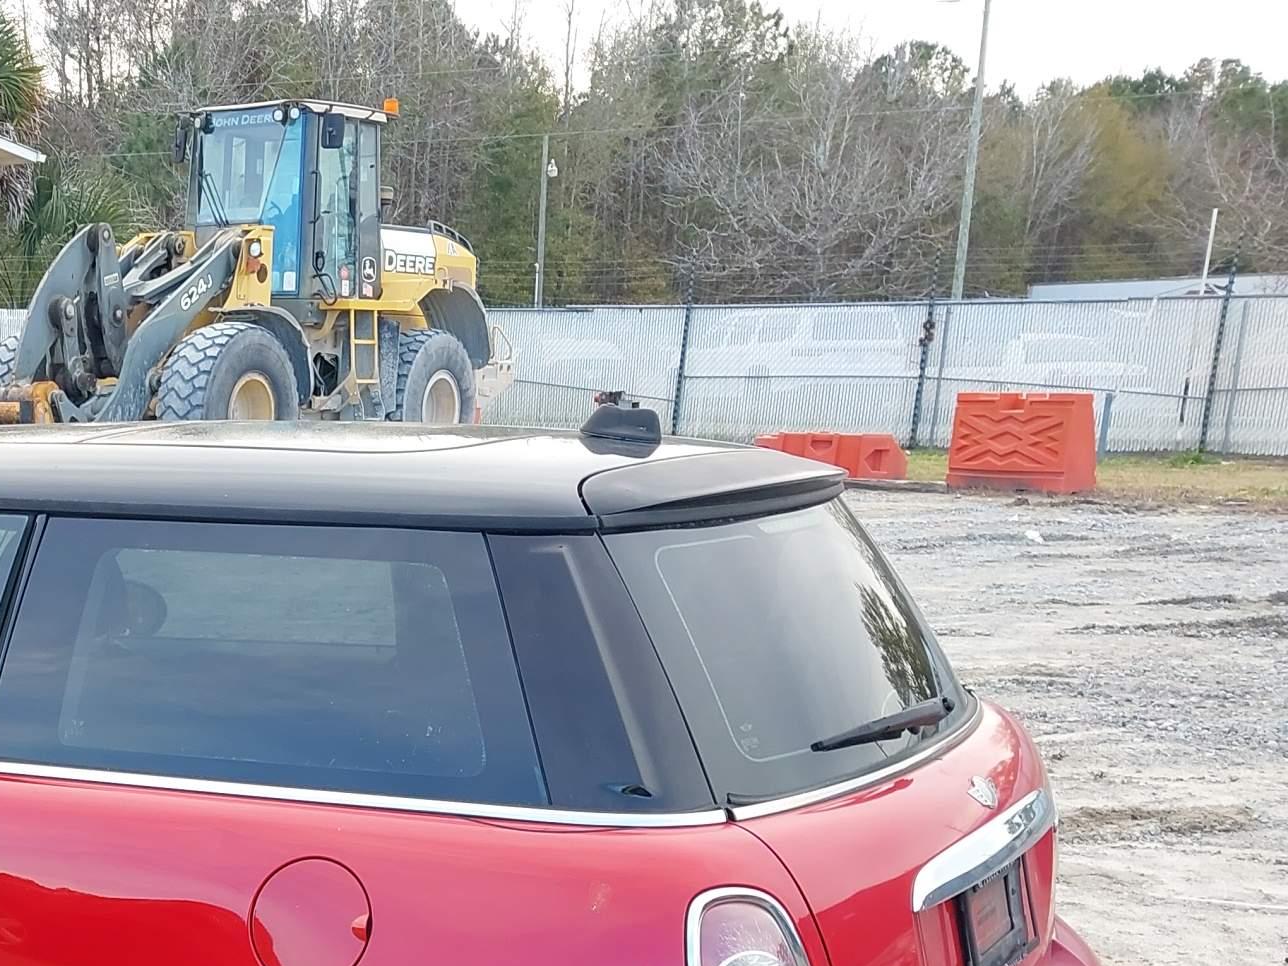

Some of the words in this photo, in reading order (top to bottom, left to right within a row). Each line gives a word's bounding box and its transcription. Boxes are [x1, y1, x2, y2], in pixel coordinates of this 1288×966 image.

[241, 113, 276, 125] DEER
[384, 249, 435, 274] DEERE
[180, 273, 213, 311] 624J
